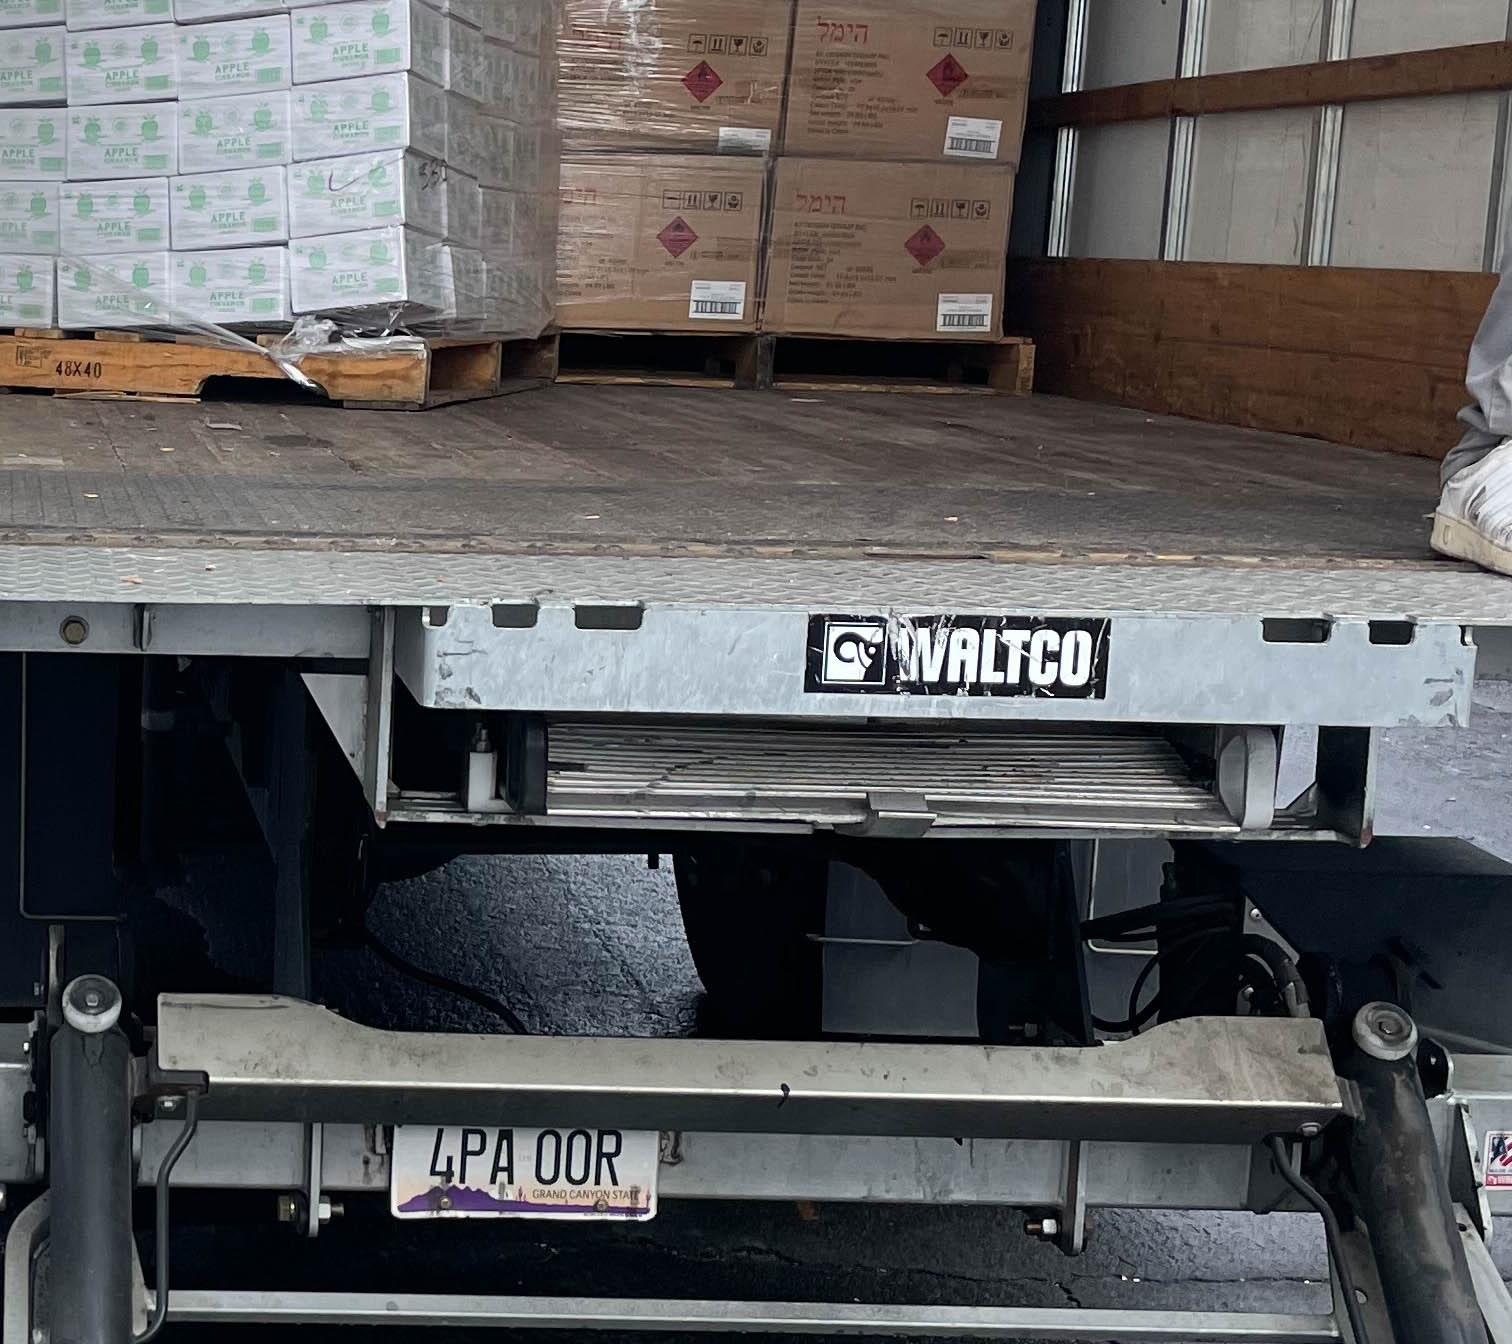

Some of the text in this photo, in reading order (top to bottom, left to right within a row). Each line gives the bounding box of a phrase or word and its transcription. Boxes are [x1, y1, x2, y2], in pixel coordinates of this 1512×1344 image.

[333, 42, 369, 55] APPLE
[215, 62, 249, 73] APPLE
[0, 70, 33, 80] APPLE
[105, 69, 138, 81] APPLE
[333, 120, 369, 133] APPLE
[217, 137, 251, 147] APPLE
[2, 149, 36, 158] APPLE
[104, 147, 138, 157] APPLE
[331, 195, 367, 209] APPLE
[211, 211, 245, 224] APPLE
[96, 221, 131, 232] APPLE
[332, 272, 368, 285] APPLE
[210, 292, 244, 301] APPLE
[56, 360, 102, 378] 48X40
[899, 627, 1092, 686] WALTCO
[430, 1128, 514, 1185] 4PA
[532, 1189, 567, 1199] GRAND
[569, 1189, 610, 1200] CANYON
